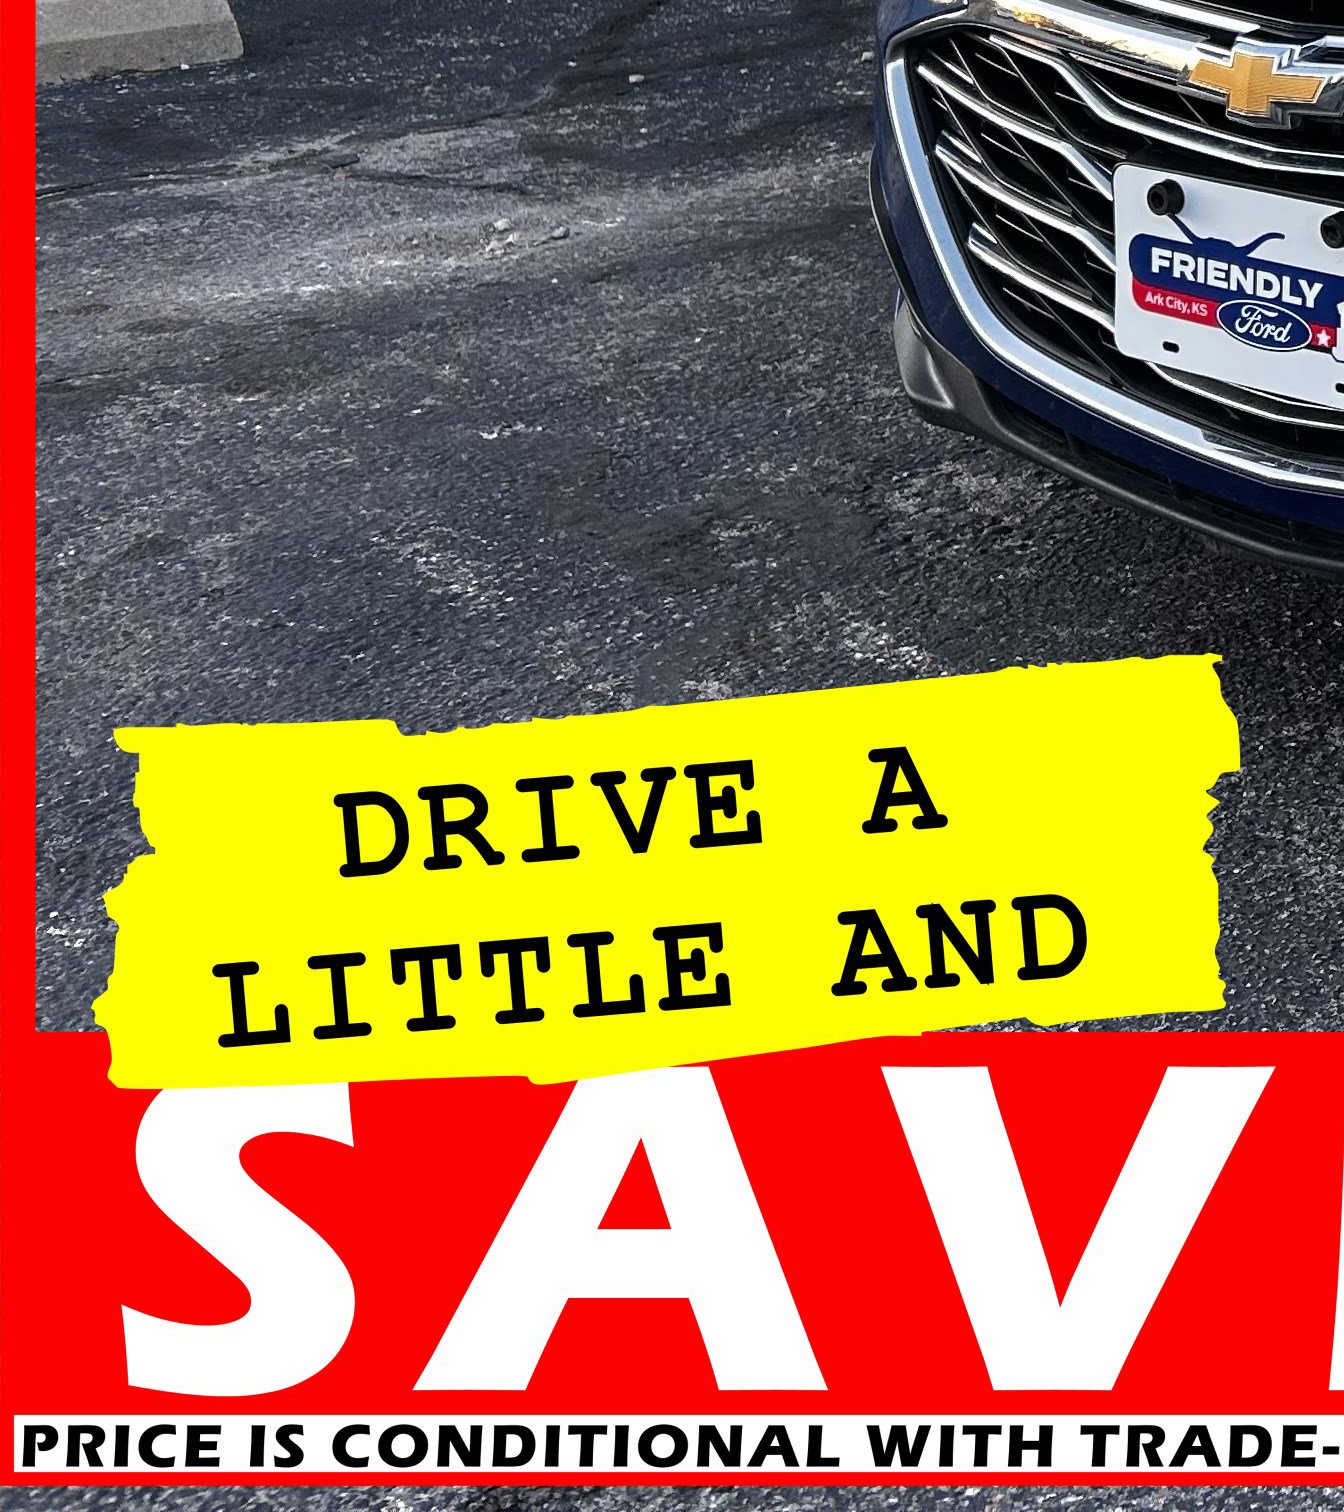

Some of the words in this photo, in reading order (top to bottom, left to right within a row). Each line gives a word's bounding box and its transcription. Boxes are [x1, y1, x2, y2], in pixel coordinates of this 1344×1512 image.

[1150, 247, 1324, 310] FRIENDLY
[1145, 291, 1164, 308] Ark
[1165, 294, 1191, 316] City,
[1191, 300, 1208, 318] KS
[1234, 304, 1293, 344] Ford
